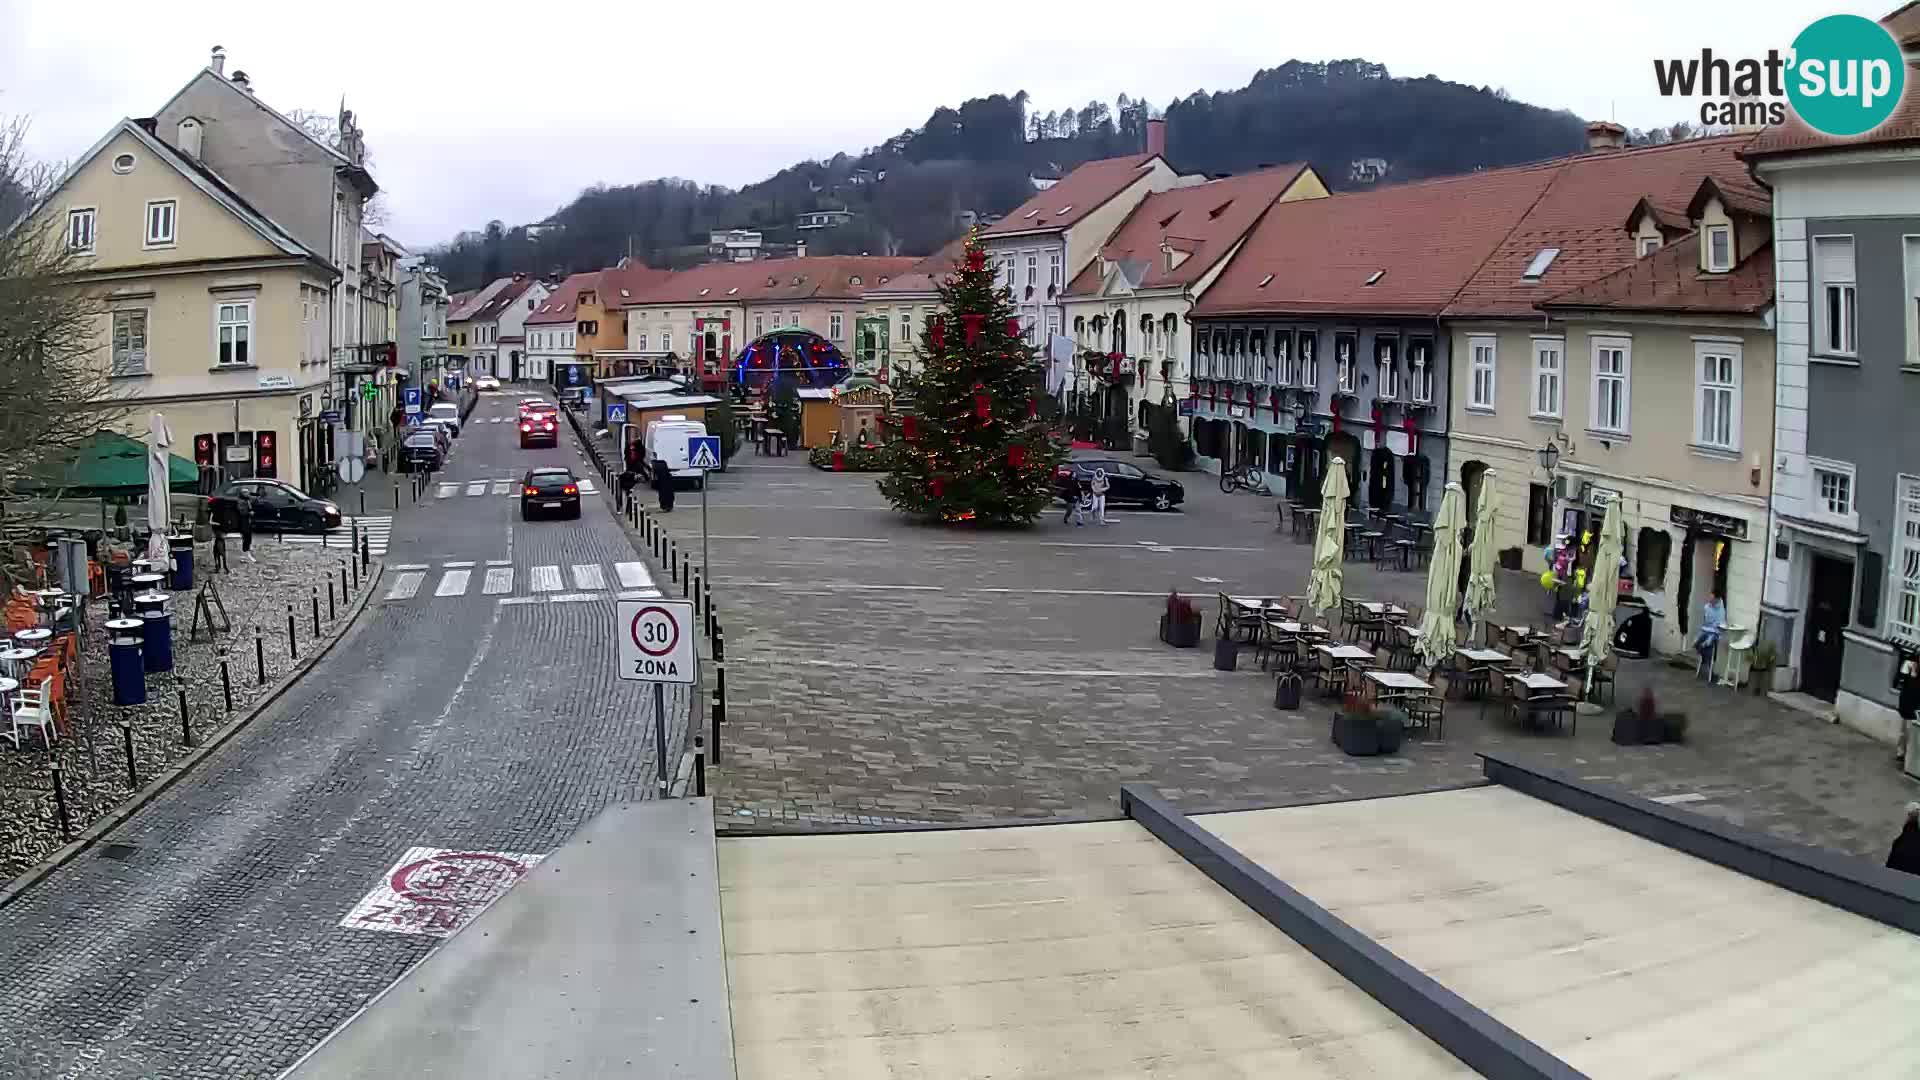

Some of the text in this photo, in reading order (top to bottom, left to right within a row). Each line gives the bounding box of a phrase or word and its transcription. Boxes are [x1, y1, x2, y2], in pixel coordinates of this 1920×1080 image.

[409, 391, 416, 402] P
[643, 622, 668, 643] 30
[634, 659, 678, 676] ZONA
